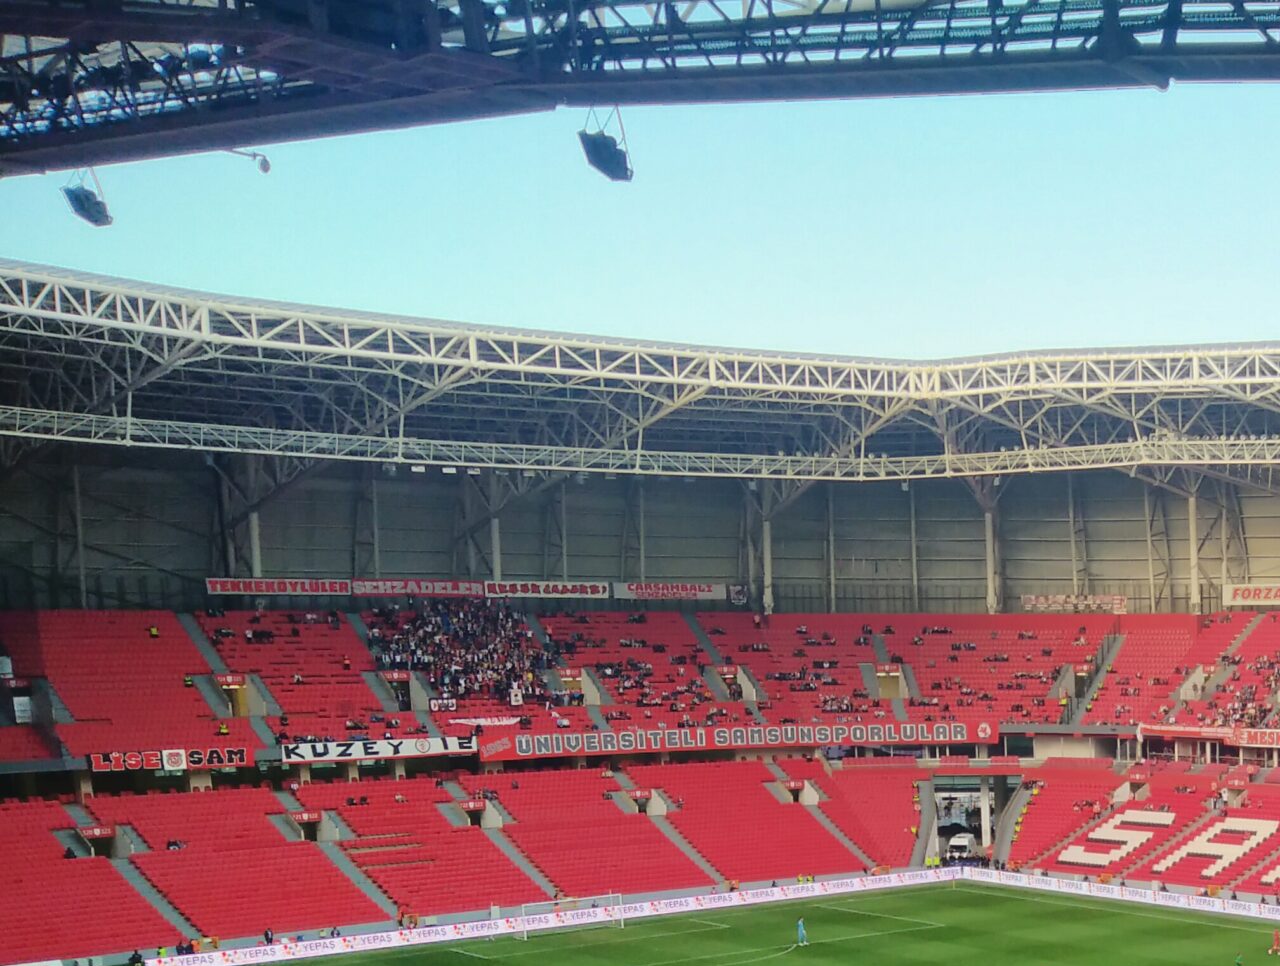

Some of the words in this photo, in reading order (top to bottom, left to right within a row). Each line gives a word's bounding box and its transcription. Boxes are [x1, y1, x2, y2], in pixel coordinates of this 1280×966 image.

[714, 723, 967, 746] SAMSUNSPORLULAR
[188, 748, 247, 767] SAM
[284, 740, 404, 760] KUZEY
